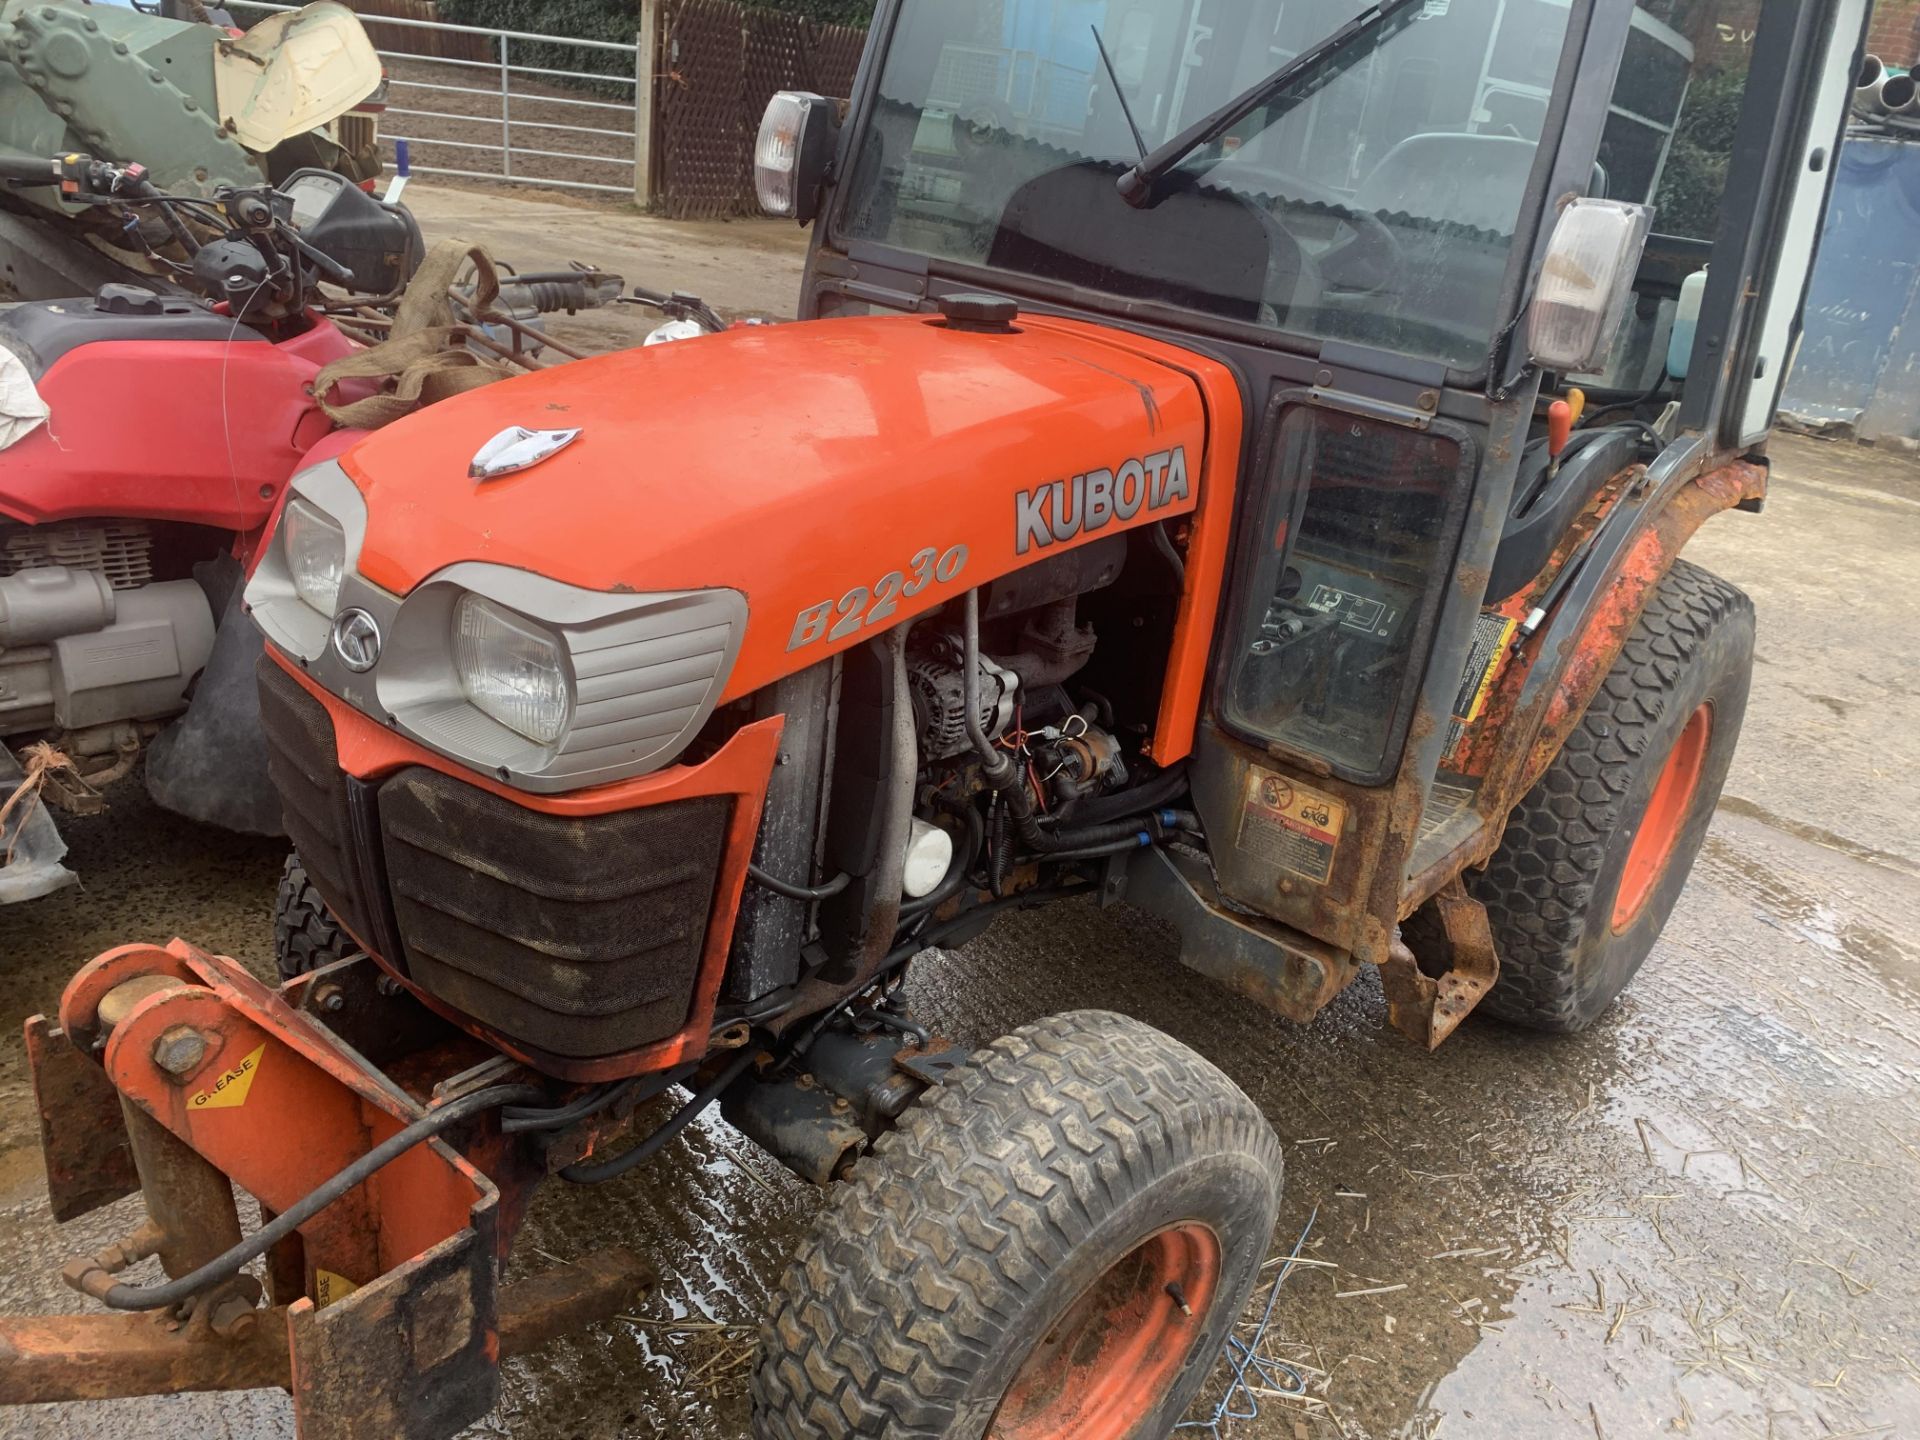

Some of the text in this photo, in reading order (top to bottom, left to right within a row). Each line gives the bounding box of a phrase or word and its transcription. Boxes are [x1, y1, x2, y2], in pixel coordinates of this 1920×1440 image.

[1016, 445, 1189, 555] KUBOTA
[786, 544, 969, 652] B2230
[195, 1059, 254, 1106] GEASE
[320, 1276, 330, 1307] EASE
